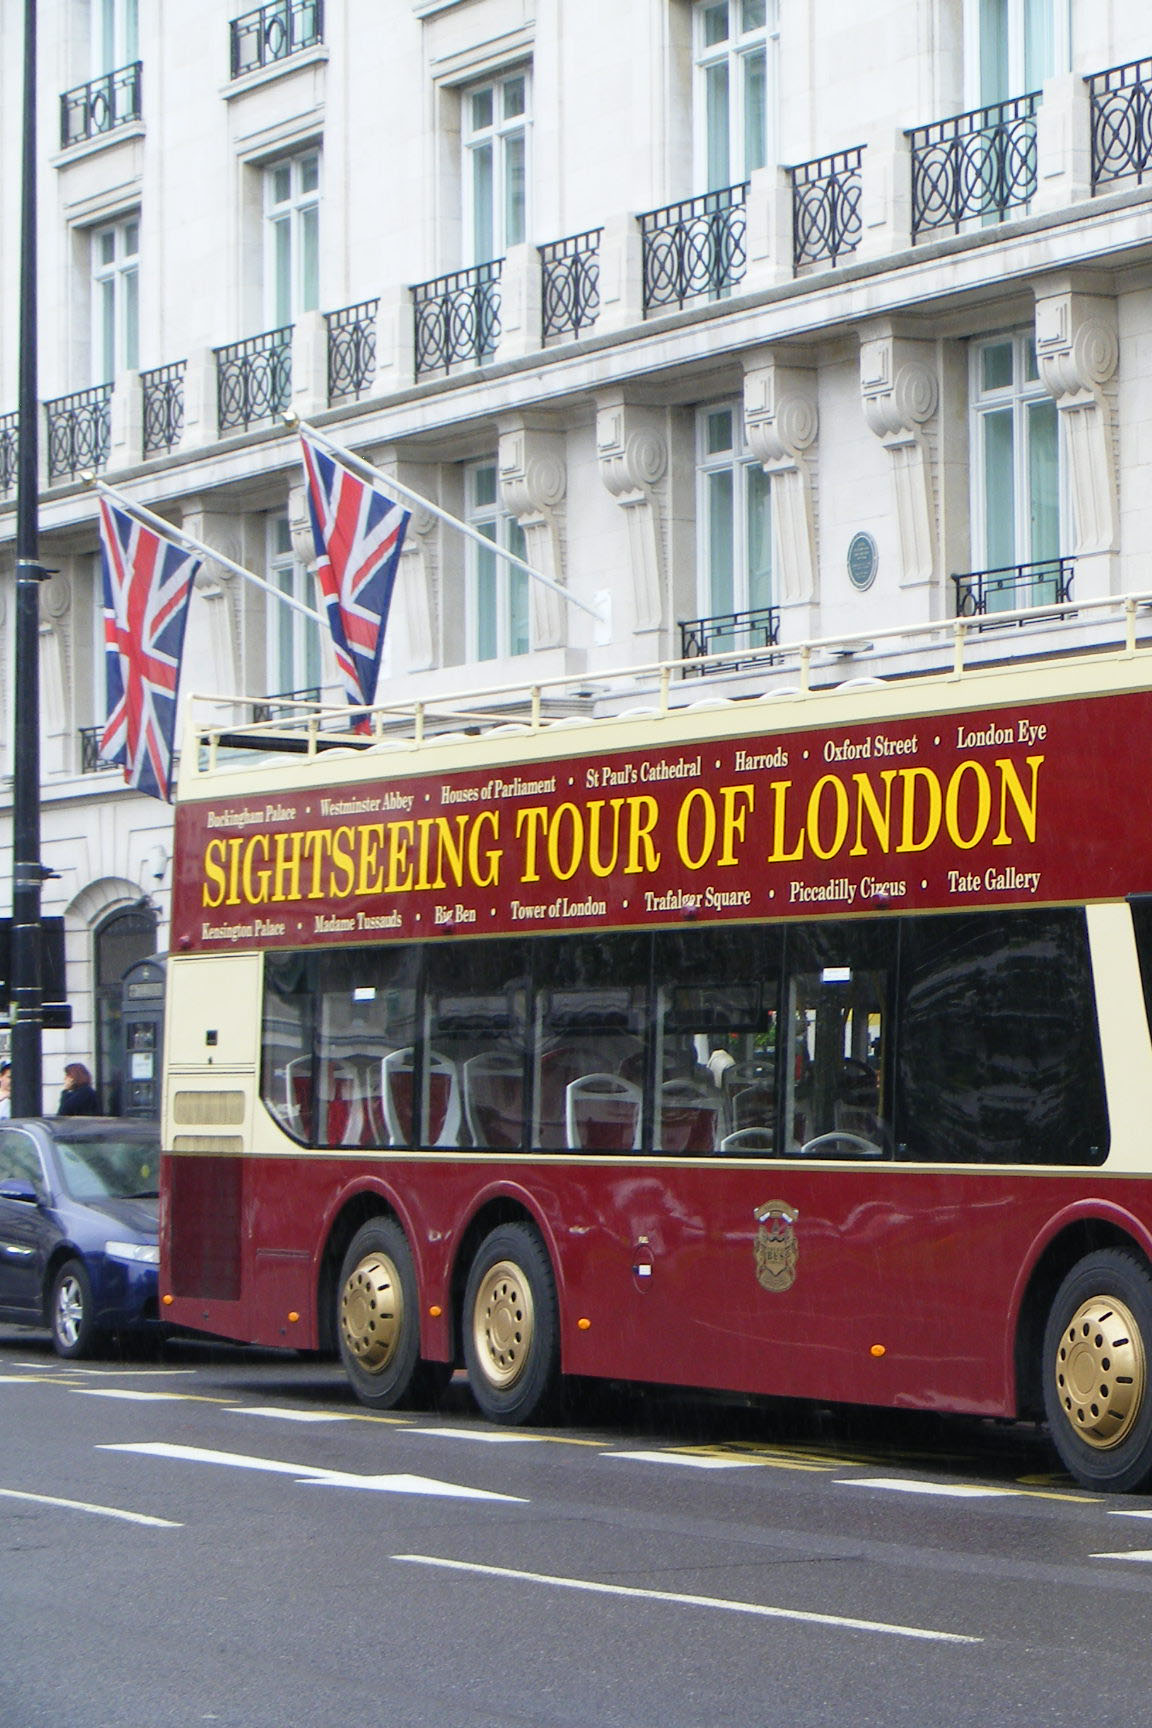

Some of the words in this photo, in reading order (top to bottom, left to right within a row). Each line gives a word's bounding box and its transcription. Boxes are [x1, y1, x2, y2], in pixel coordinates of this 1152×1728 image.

[207, 808, 264, 829] Buckingham
[266, 804, 296, 823] Palace
[320, 797, 382, 817] Westminster
[382, 792, 414, 811] Abbey
[441, 785, 479, 805] Houses
[481, 781, 494, 800] of
[494, 776, 557, 799] Parliament
[586, 768, 600, 789] St
[601, 765, 637, 787] Paul's
[640, 756, 702, 782] Cathedral
[735, 748, 789, 773] Harrods
[824, 738, 871, 763] Oxford
[874, 735, 918, 758] Street
[957, 723, 1014, 749] London
[1017, 719, 1047, 746] Eye
[202, 810, 503, 909] SIGHTSEEING
[515, 795, 661, 881] TOUR
[677, 784, 755, 870] OF
[768, 755, 1045, 863] LONDON
[202, 922, 252, 942] Kensington
[254, 919, 286, 937] Palace
[314, 914, 355, 934] Madame
[357, 909, 402, 931] Tussauds
[435, 905, 454, 925] Big
[455, 904, 476, 923] Ben
[511, 900, 546, 920] Tower
[548, 898, 563, 918] of
[562, 895, 607, 917] London
[706, 886, 751, 909] Square
[789, 878, 857, 905] Piccadilly
[860, 875, 906, 899] Circus
[948, 869, 981, 893] Tate
[984, 866, 1041, 893] Gallery
